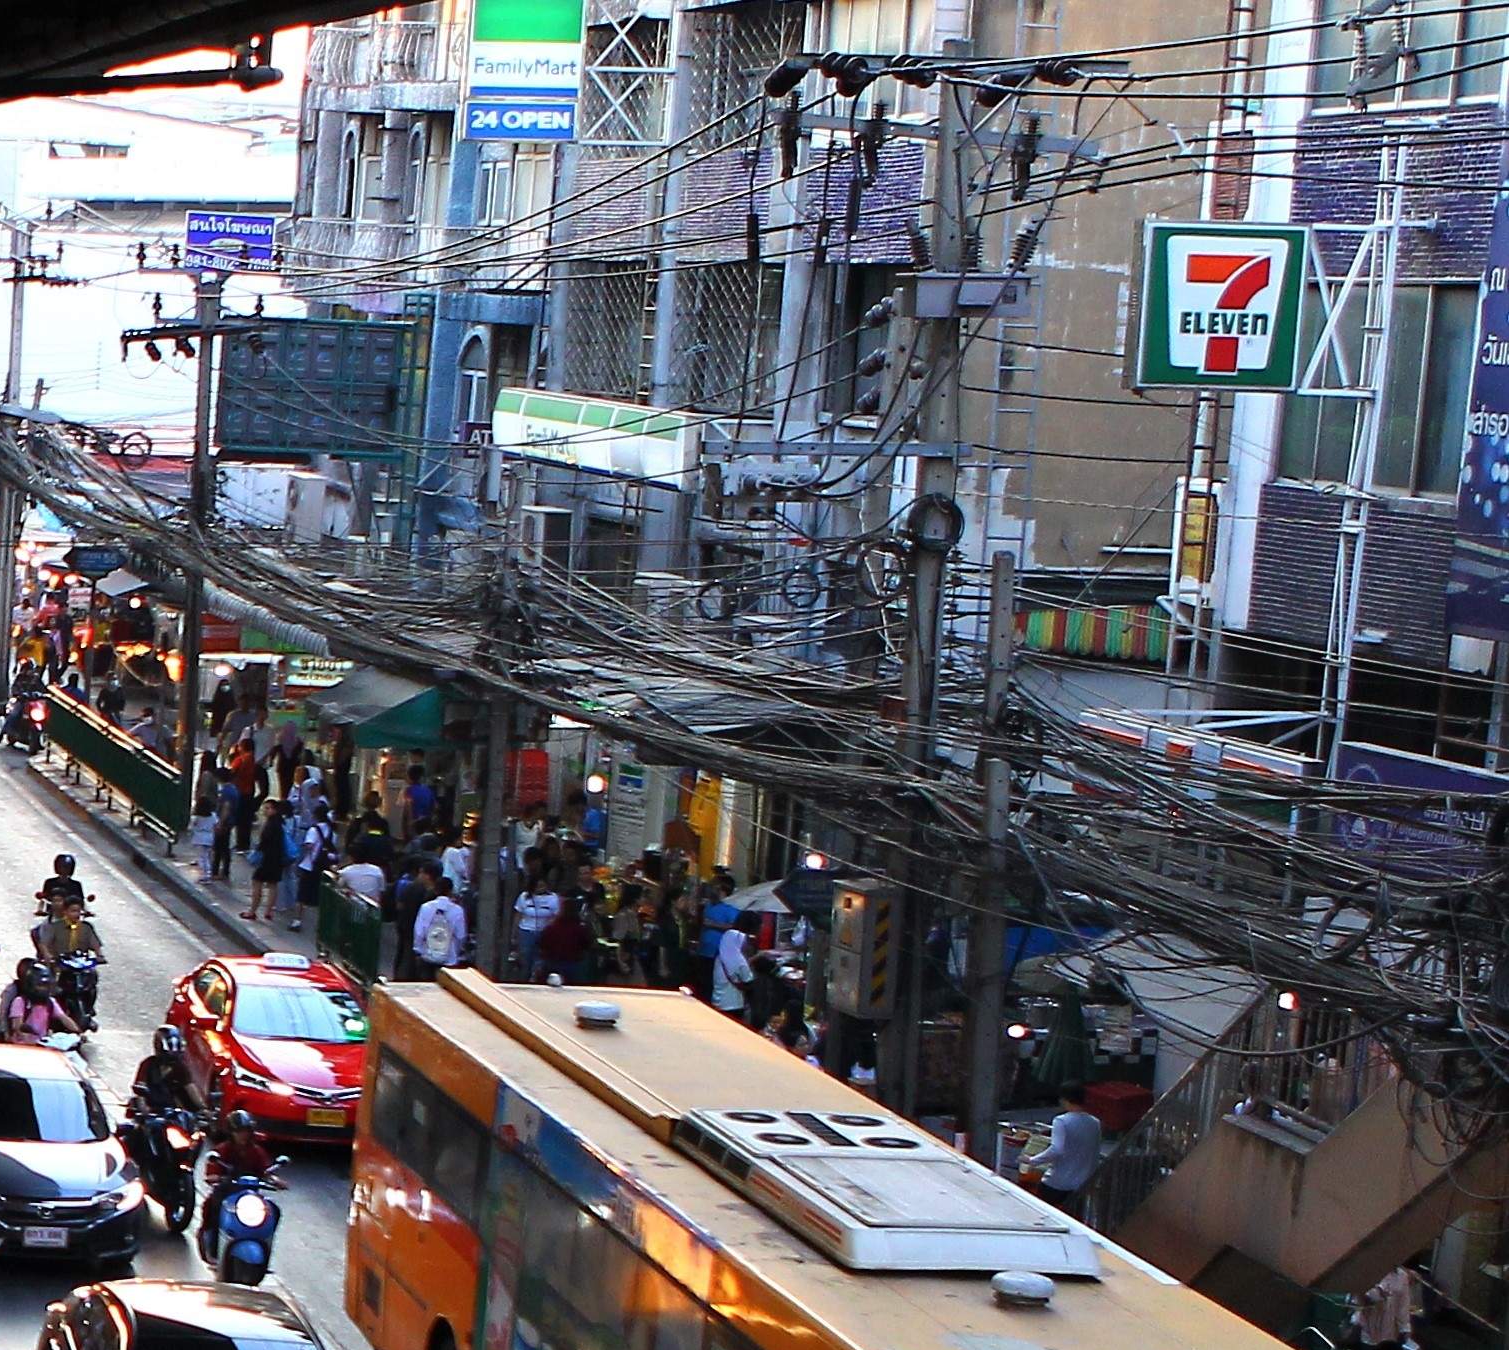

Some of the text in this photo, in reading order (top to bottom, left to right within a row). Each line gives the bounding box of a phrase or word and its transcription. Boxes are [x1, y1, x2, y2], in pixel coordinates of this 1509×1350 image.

[474, 57, 577, 78] FamilyMart
[470, 110, 571, 130] 24 OPEN
[189, 216, 272, 236] สนใจโฆษณา
[1186, 254, 1271, 373] 7
[1481, 334, 1509, 367] วันเ
